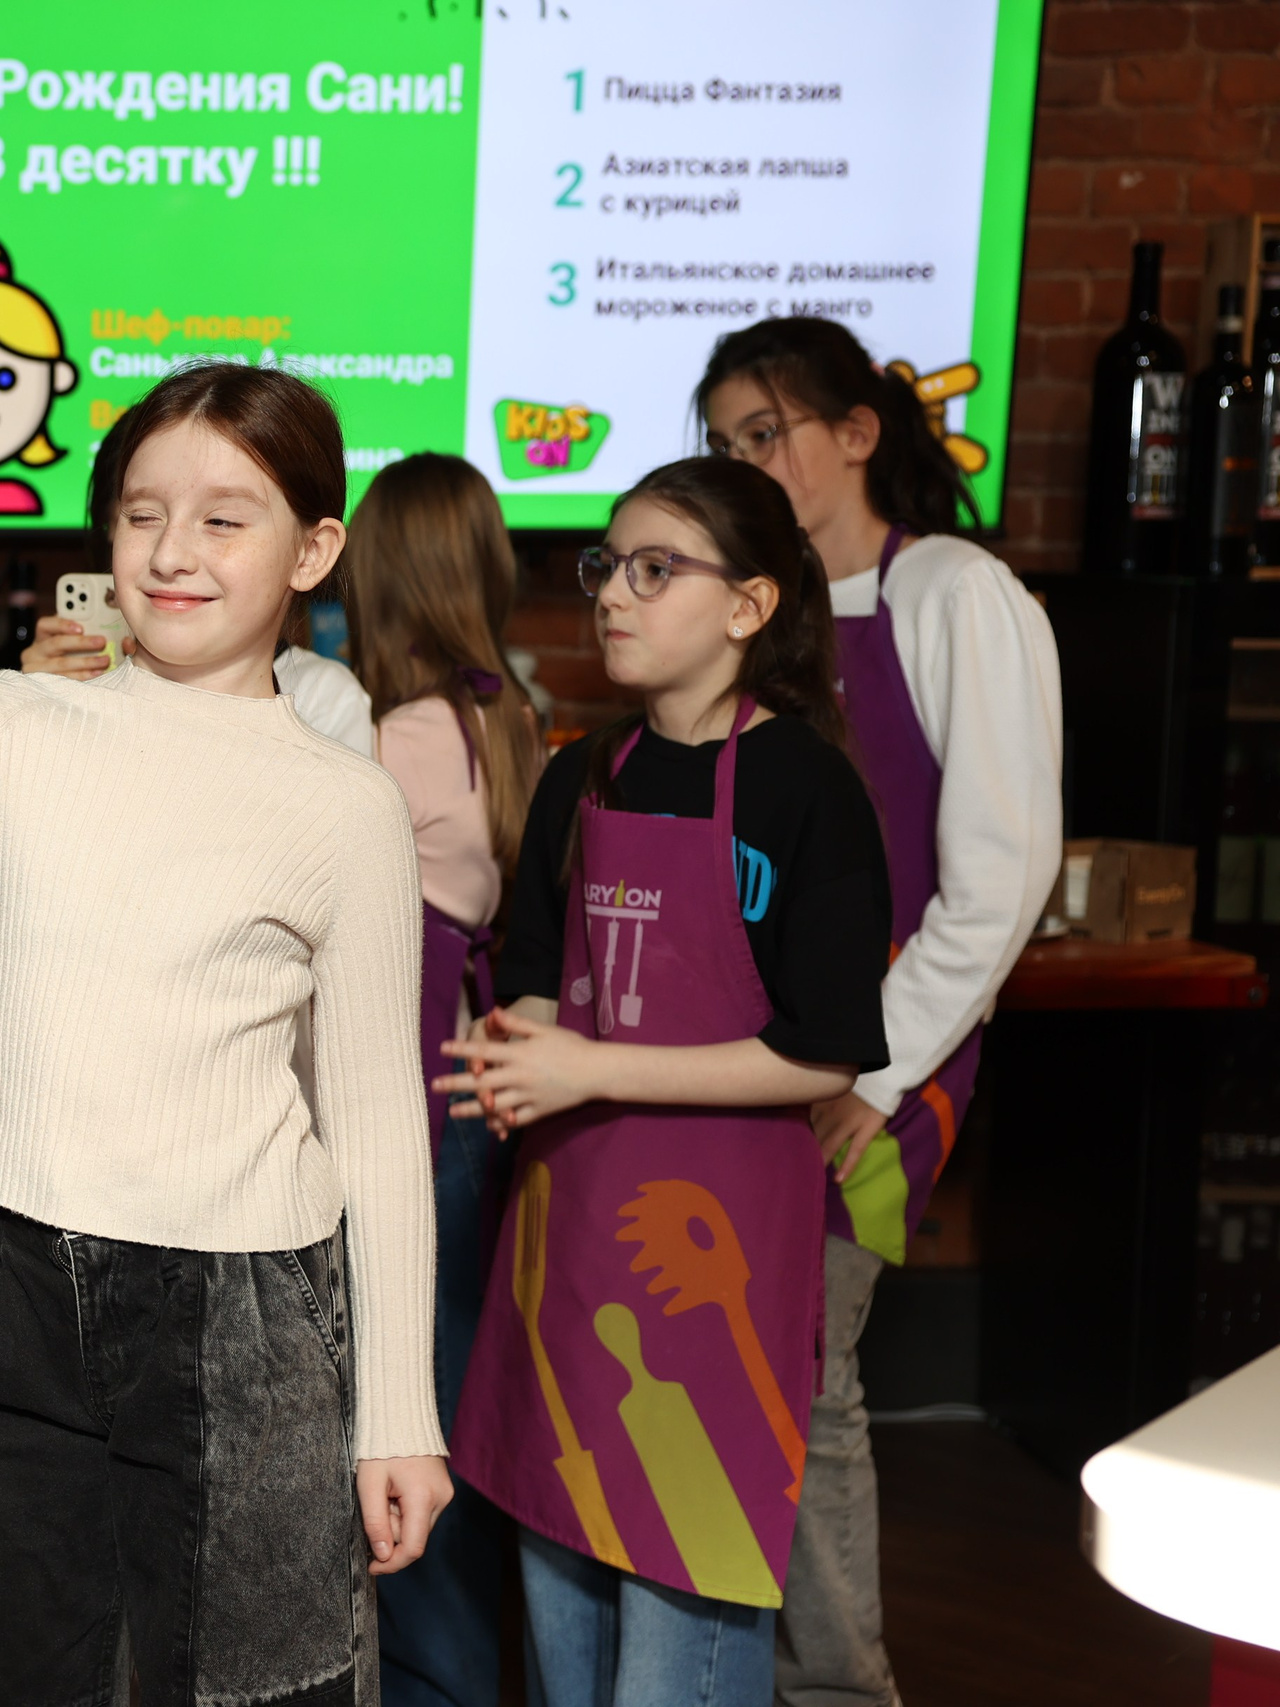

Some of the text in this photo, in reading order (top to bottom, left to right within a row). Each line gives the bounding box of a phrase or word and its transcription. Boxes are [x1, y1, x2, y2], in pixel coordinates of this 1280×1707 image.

[306, 62, 464, 114] Сани!
[564, 69, 585, 112] 1
[604, 77, 842, 105] Пицца Фантазия
[19, 144, 258, 197] десятку
[272, 136, 321, 185] !!!
[602, 154, 850, 178] Азиатская лапша
[555, 163, 584, 208] 2
[624, 190, 741, 219] курицей
[547, 262, 578, 306] 3
[596, 258, 936, 285] Итальянское домашнее
[90, 309, 292, 345] Шеф-повар:
[595, 298, 758, 321] мороженое
[791, 298, 872, 318] манго
